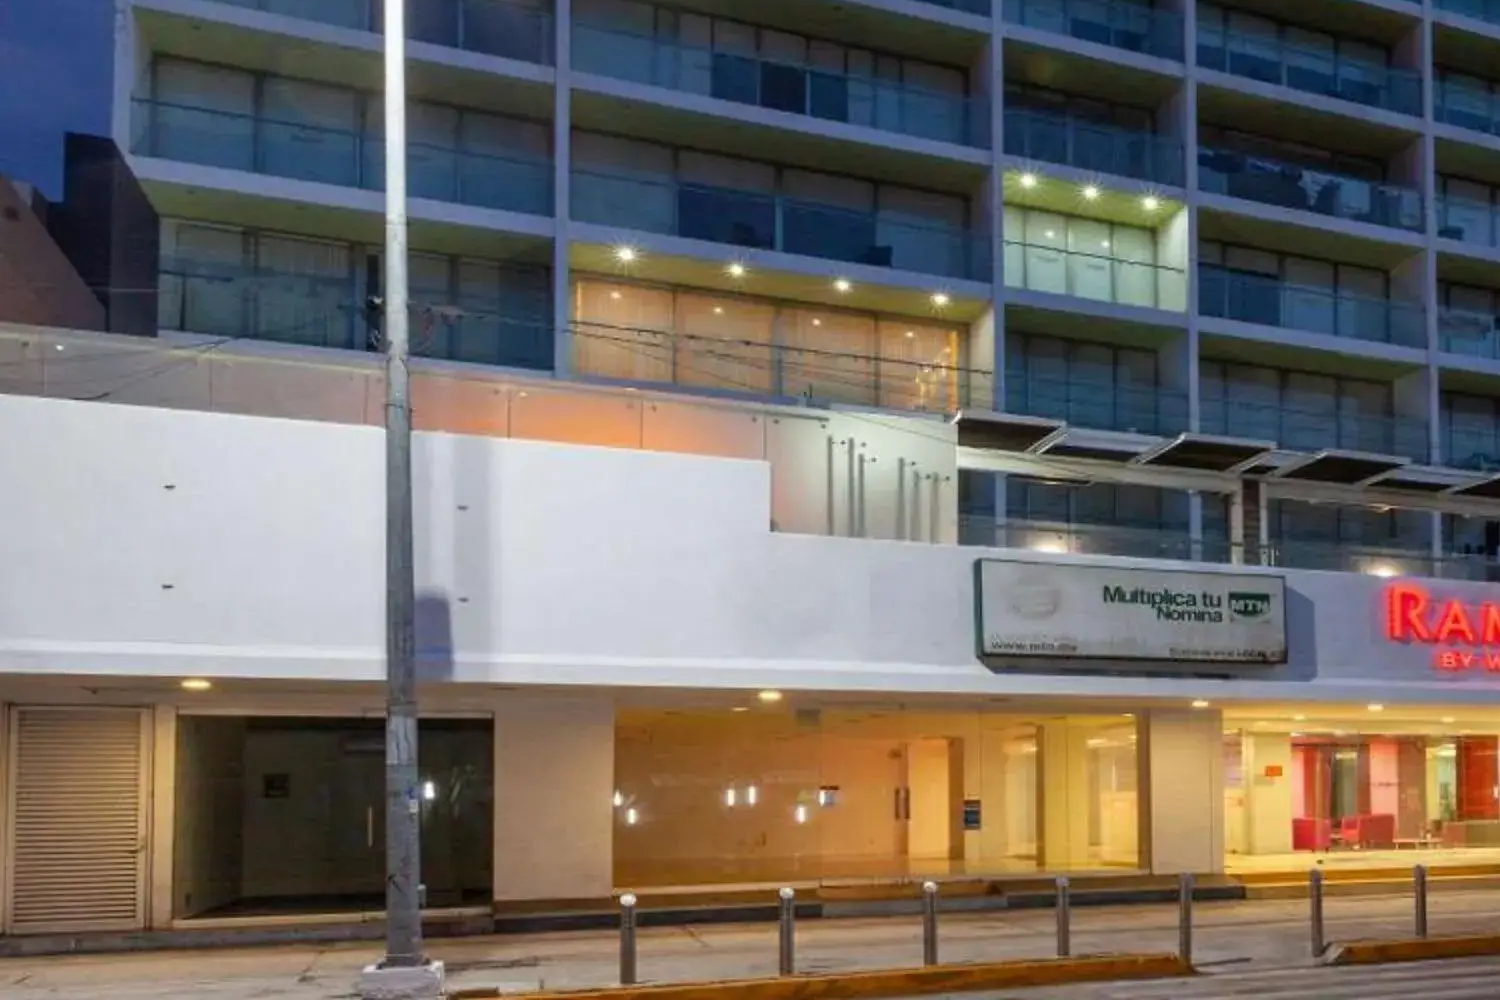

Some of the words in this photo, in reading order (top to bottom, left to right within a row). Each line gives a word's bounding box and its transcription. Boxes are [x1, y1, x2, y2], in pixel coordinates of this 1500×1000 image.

[1103, 585, 1197, 609] Multiplica
[1202, 592, 1222, 608] tu
[1439, 650, 1474, 669] BY
